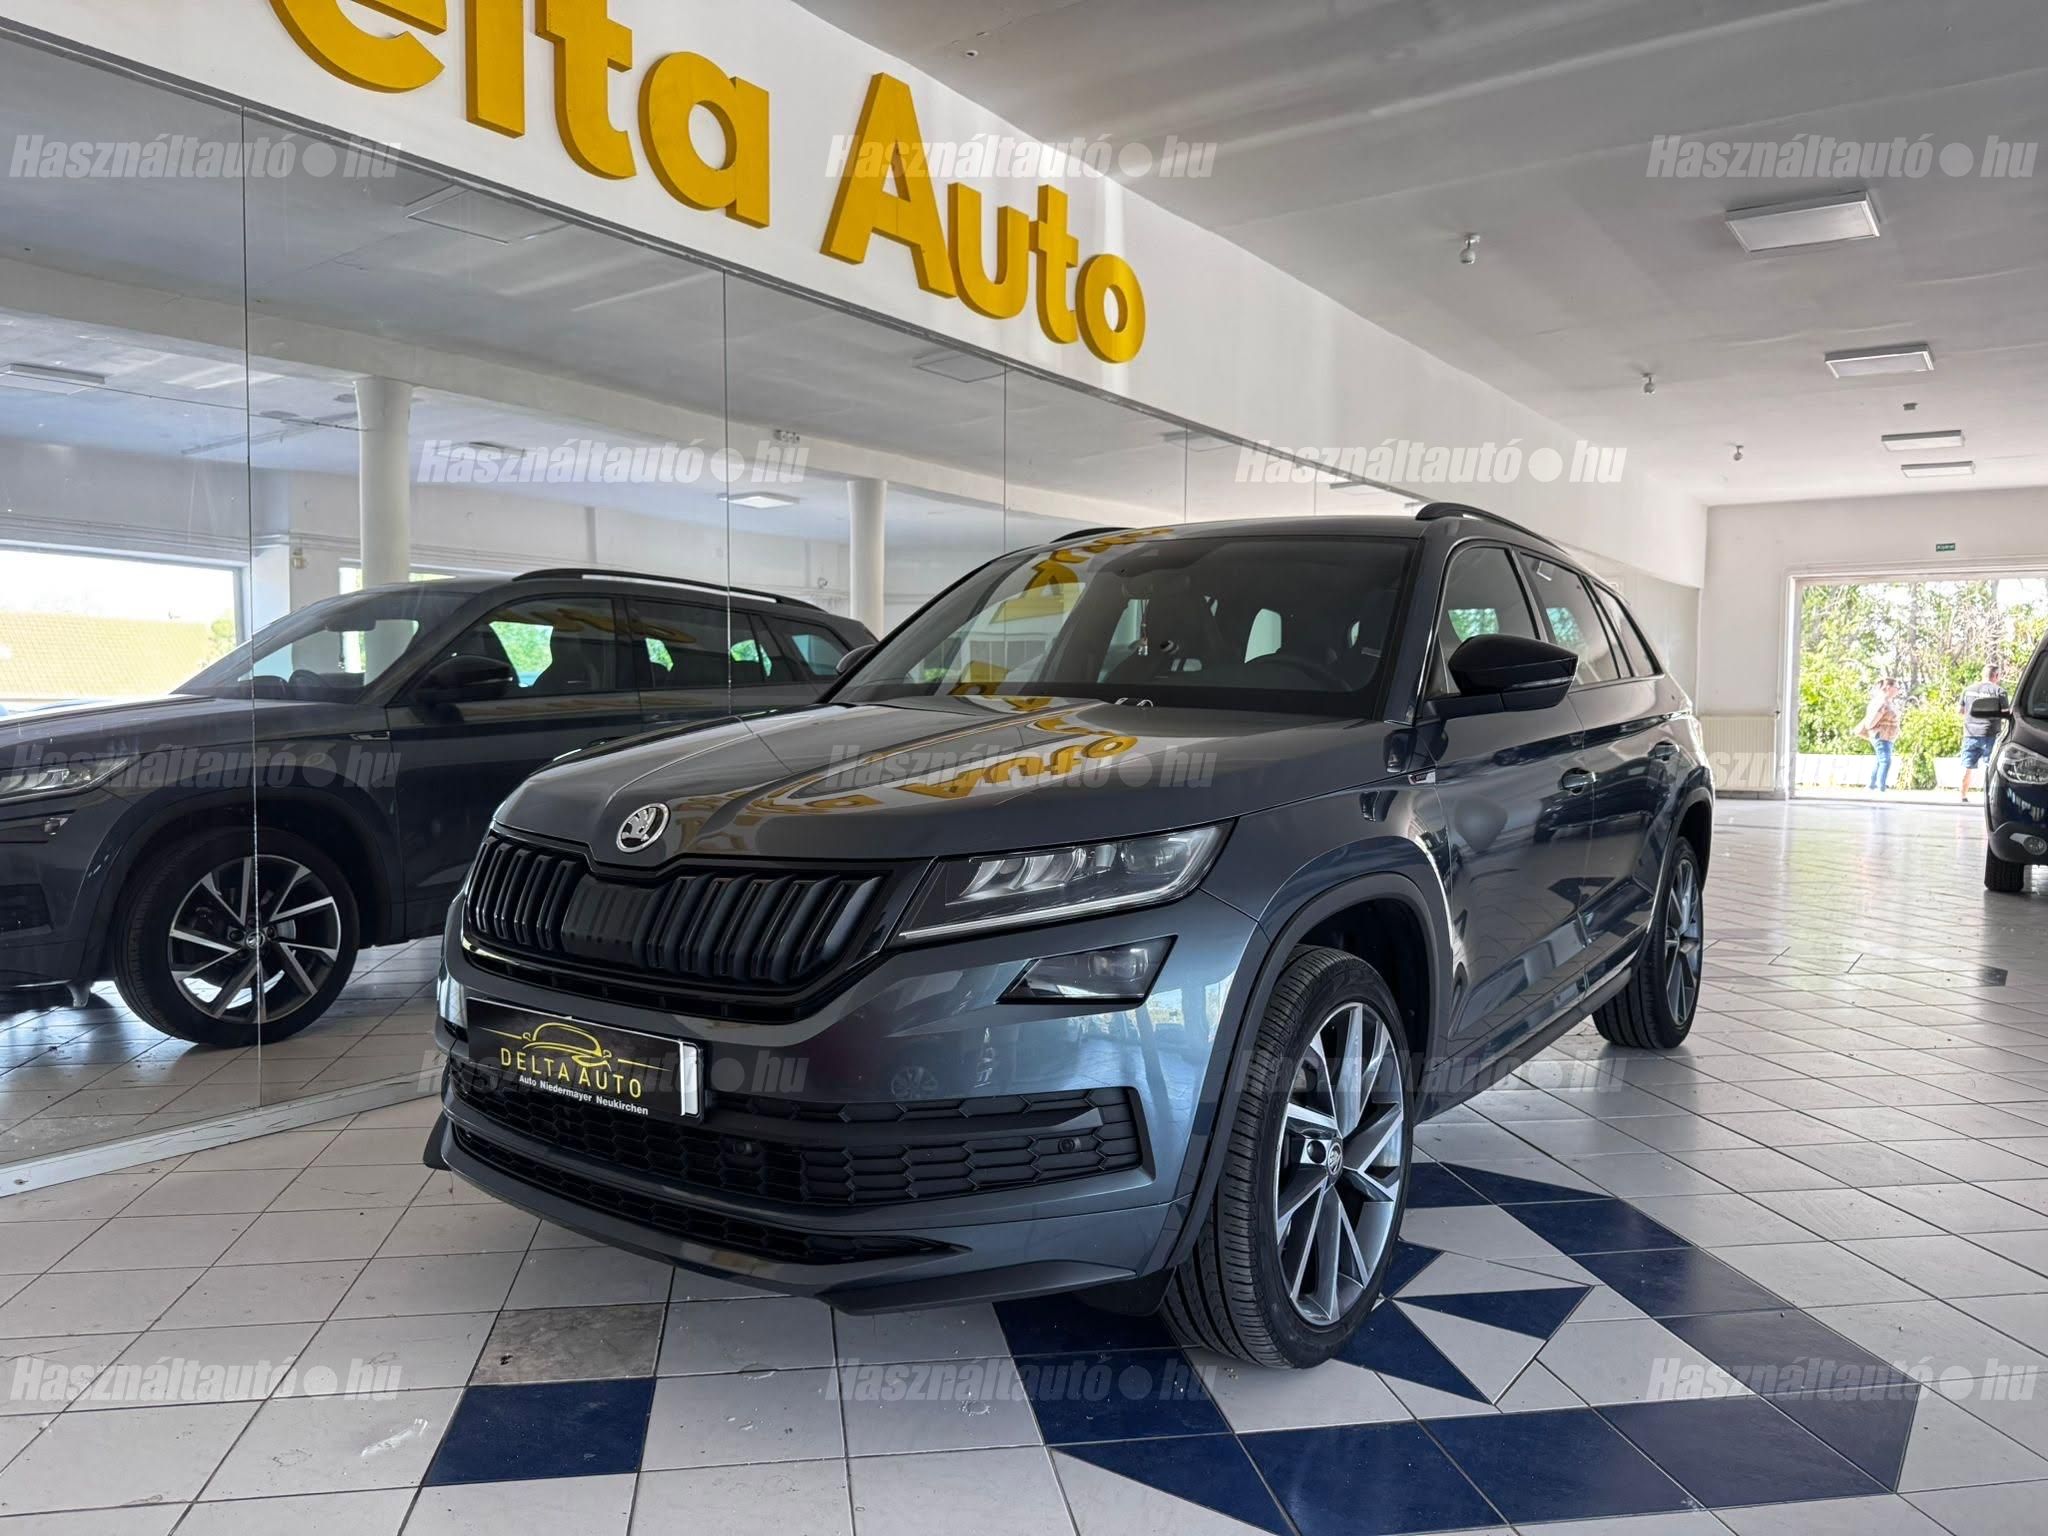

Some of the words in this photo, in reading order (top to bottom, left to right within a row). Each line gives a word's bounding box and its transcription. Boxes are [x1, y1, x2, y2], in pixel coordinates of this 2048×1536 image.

[820, 72, 1146, 364] Auto
[500, 1046, 570, 1082] DELTA
[578, 1067, 642, 1099] AUTO
[519, 1074, 537, 1087] Auto
[539, 1081, 593, 1102] Niedermayer
[595, 1095, 649, 1116] Neukirchen
